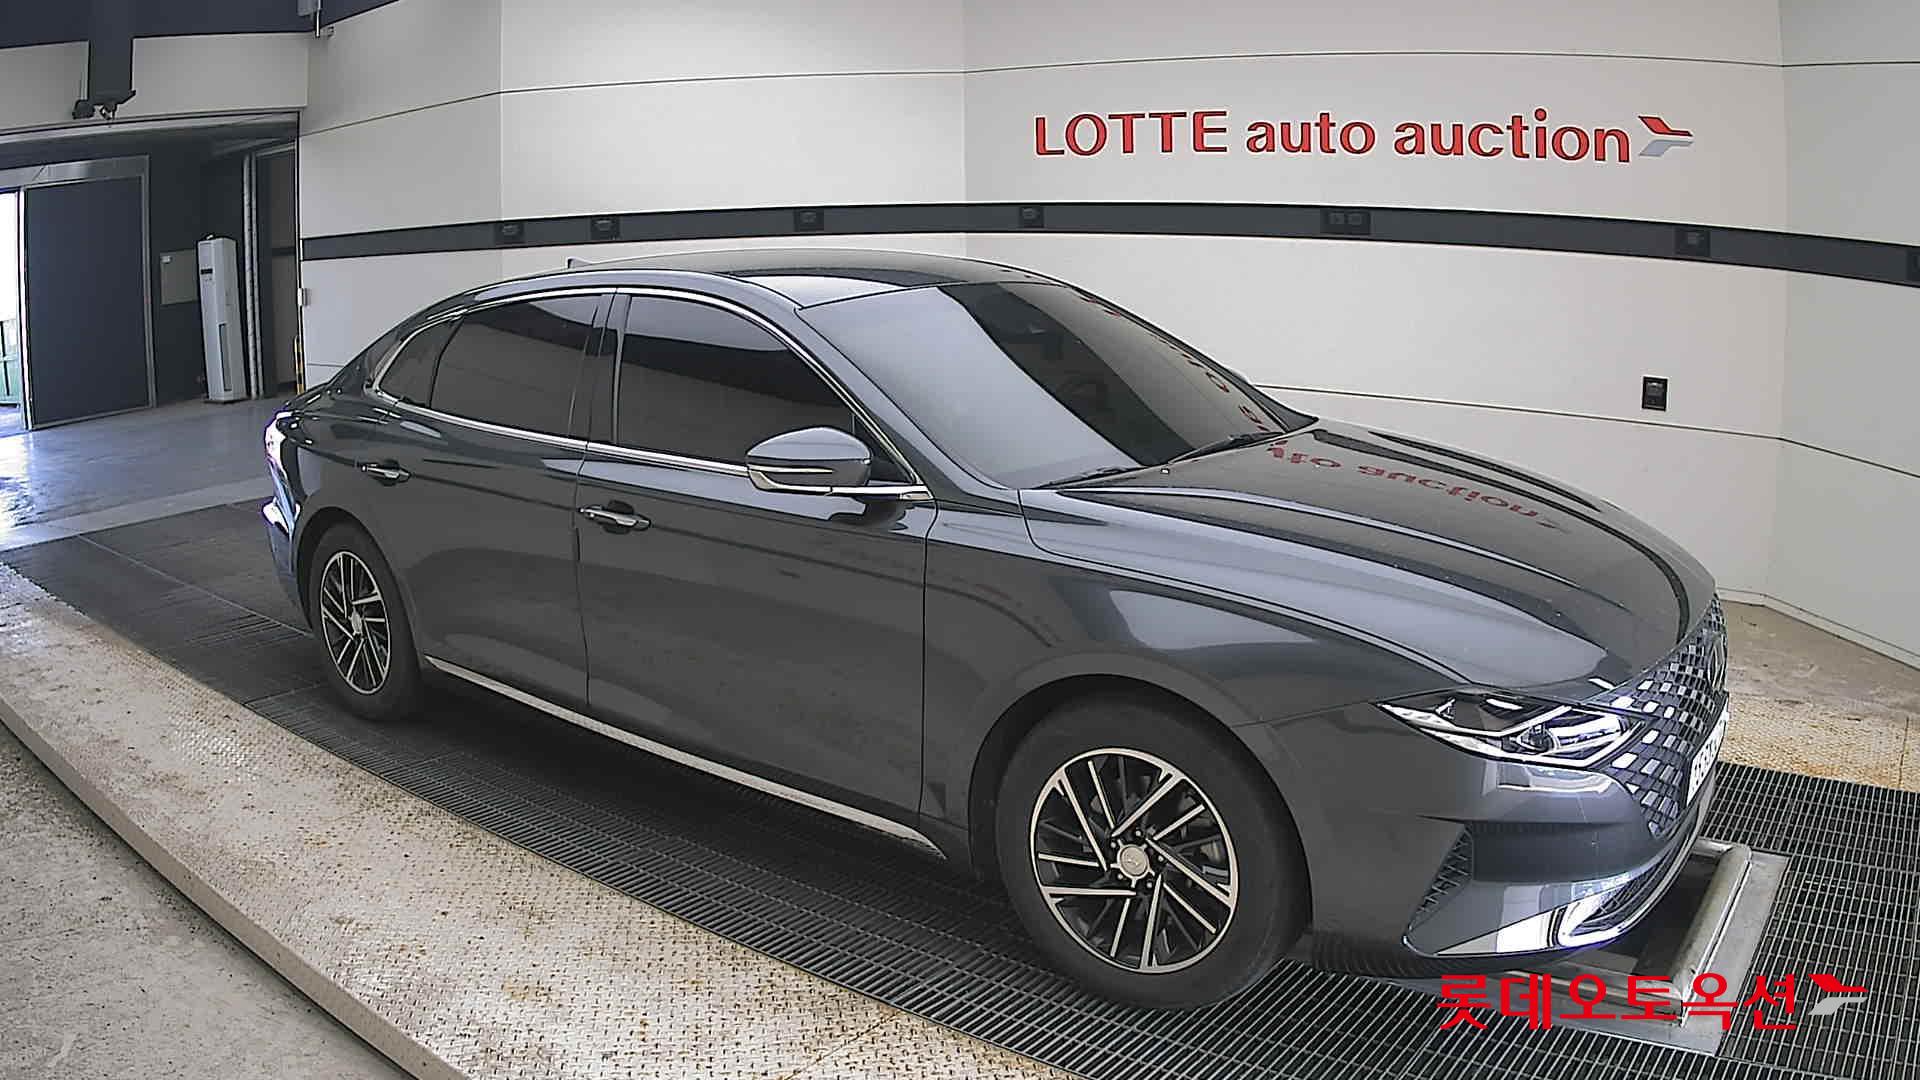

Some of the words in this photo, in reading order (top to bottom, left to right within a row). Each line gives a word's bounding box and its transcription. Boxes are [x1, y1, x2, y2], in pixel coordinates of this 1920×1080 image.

[1034, 110, 1228, 156] LOTTE
[1246, 111, 1377, 154] auto
[1392, 107, 1631, 163] auction
